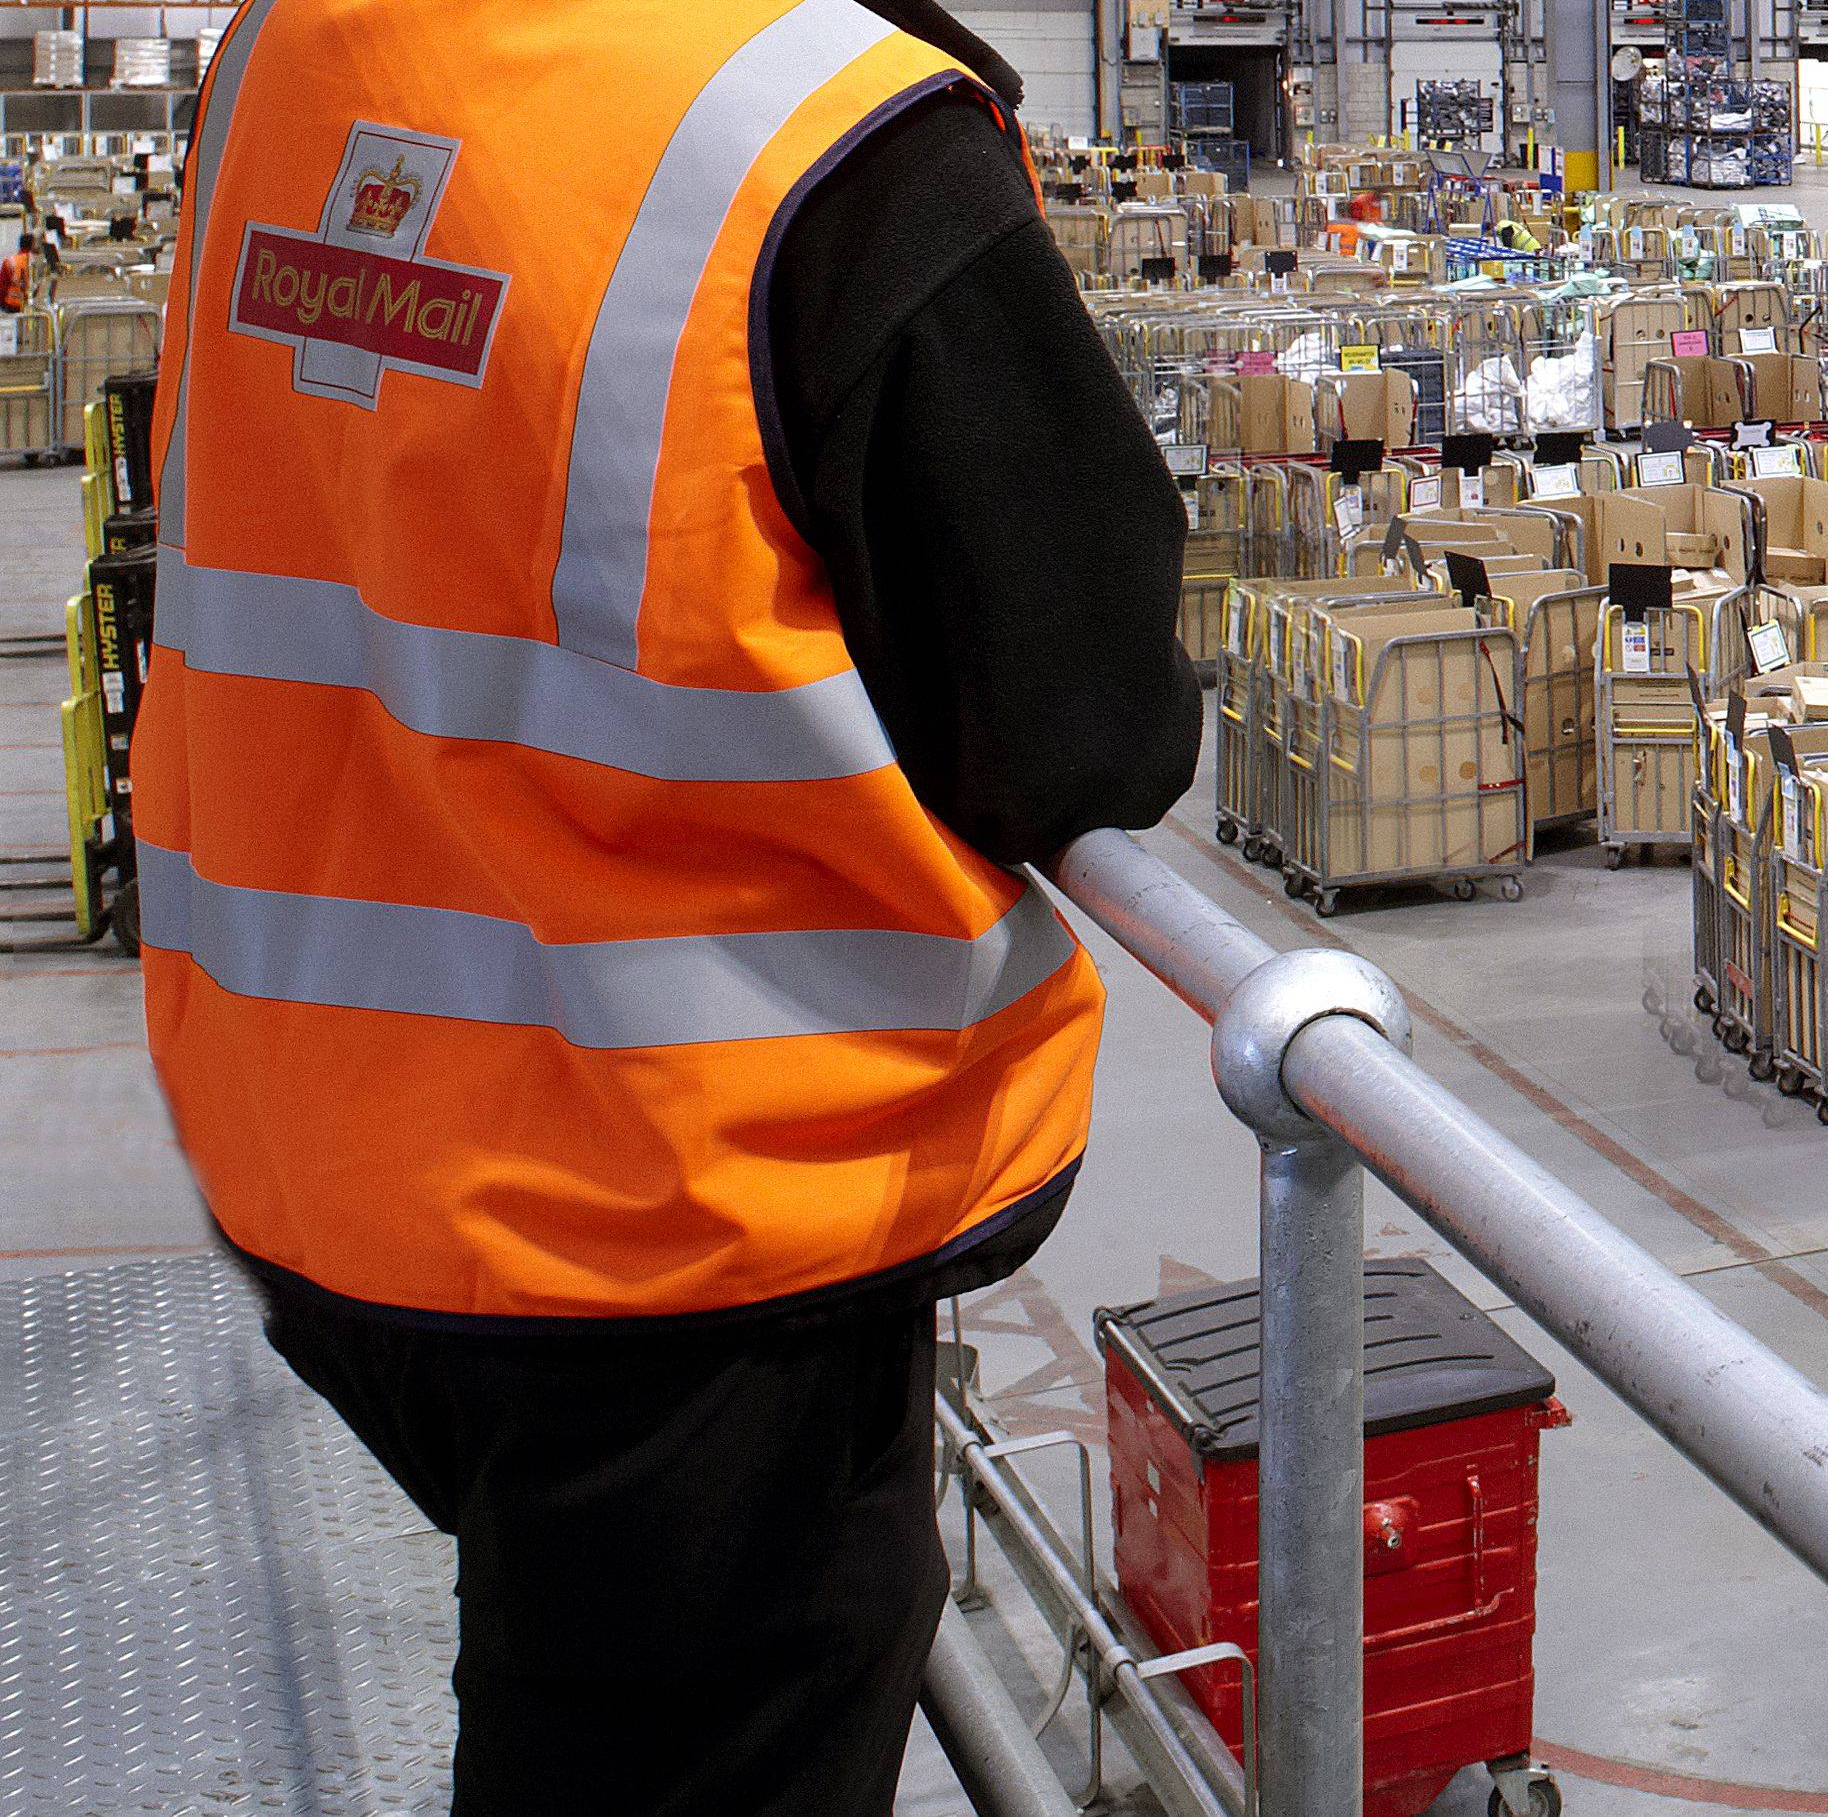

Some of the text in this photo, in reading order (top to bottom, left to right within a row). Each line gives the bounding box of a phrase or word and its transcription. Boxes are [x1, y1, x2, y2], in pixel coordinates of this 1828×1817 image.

[252, 247, 483, 346] Royal Mail
[97, 584, 120, 671] HYSTER
